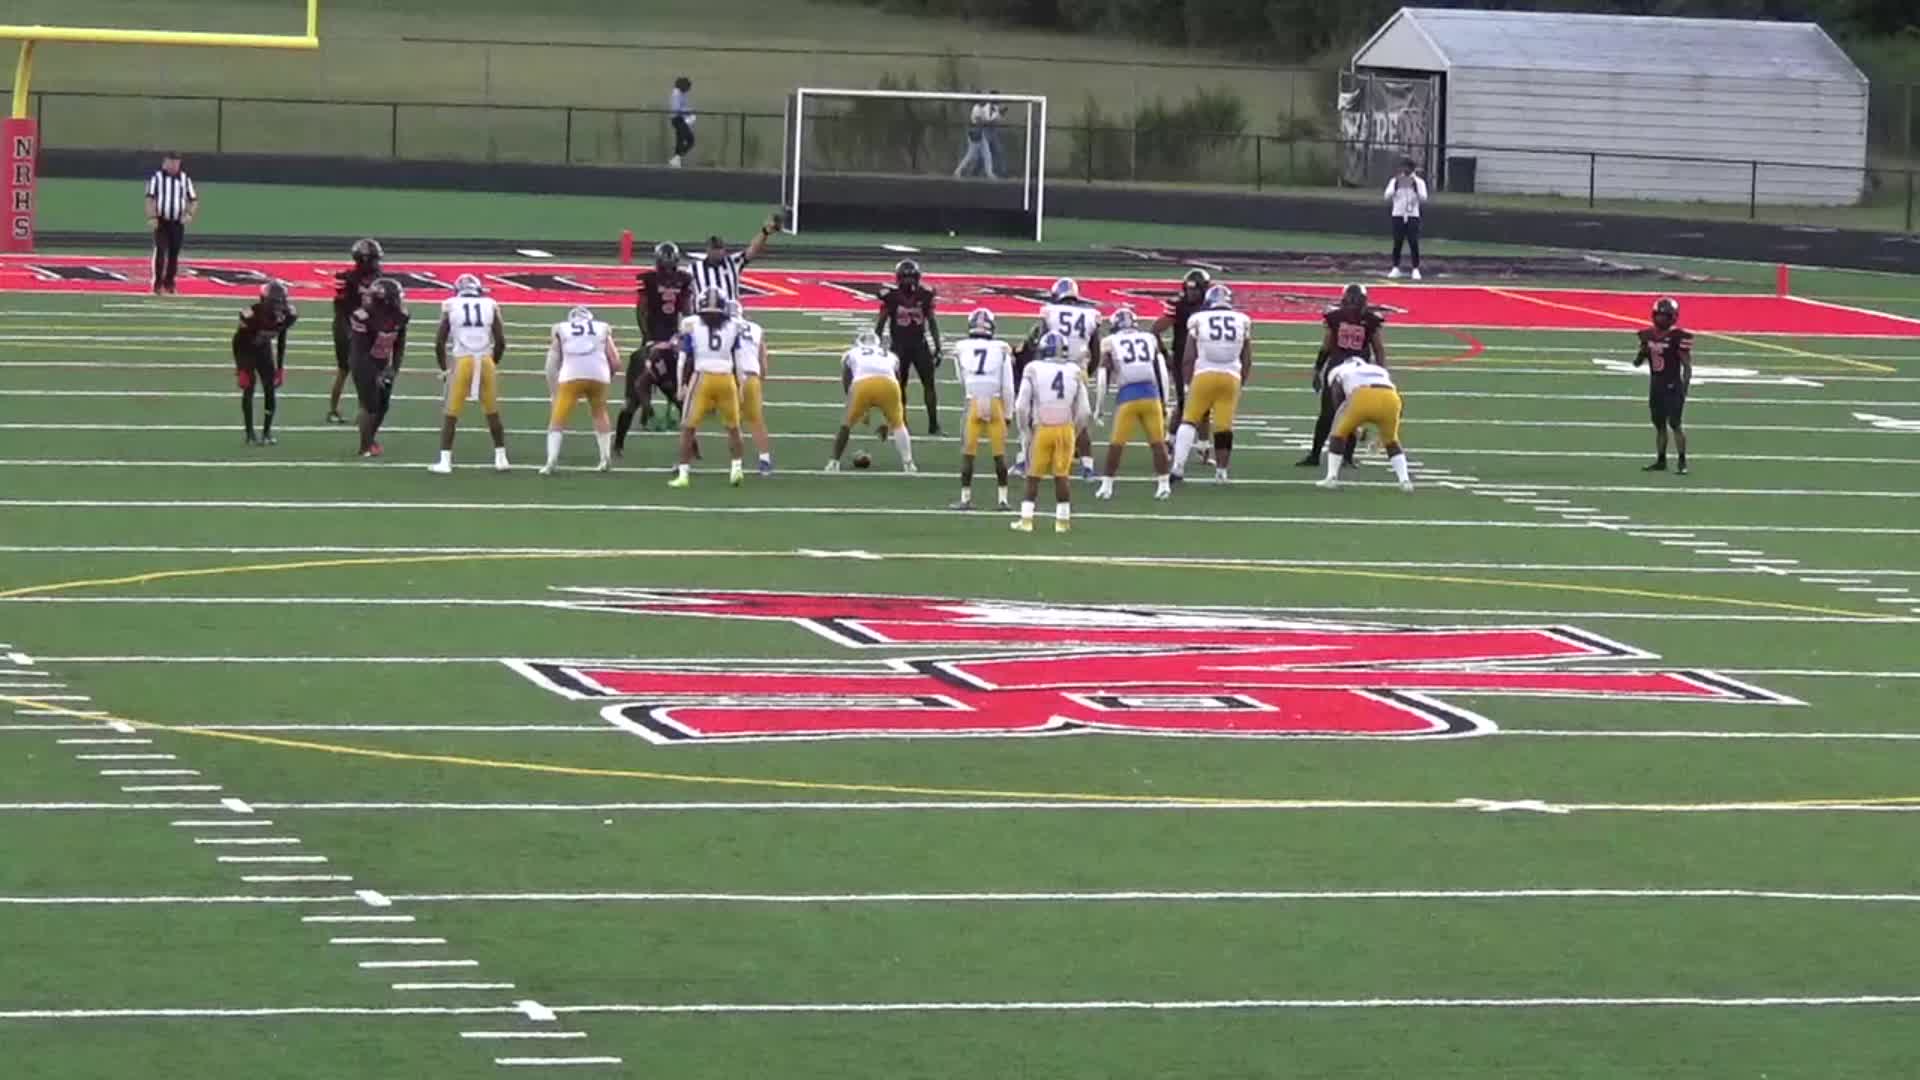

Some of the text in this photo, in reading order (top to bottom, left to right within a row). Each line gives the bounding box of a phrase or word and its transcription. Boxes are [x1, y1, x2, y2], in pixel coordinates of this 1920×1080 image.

[14, 137, 32, 239] NRHS
[462, 303, 484, 327] 11
[1059, 312, 1086, 338] 54
[571, 320, 596, 336] 51
[708, 329, 721, 351] 6
[1209, 316, 1237, 341] 55
[973, 349, 988, 376] 7
[1121, 340, 1150, 363] 33
[1051, 371, 1065, 399] 4
